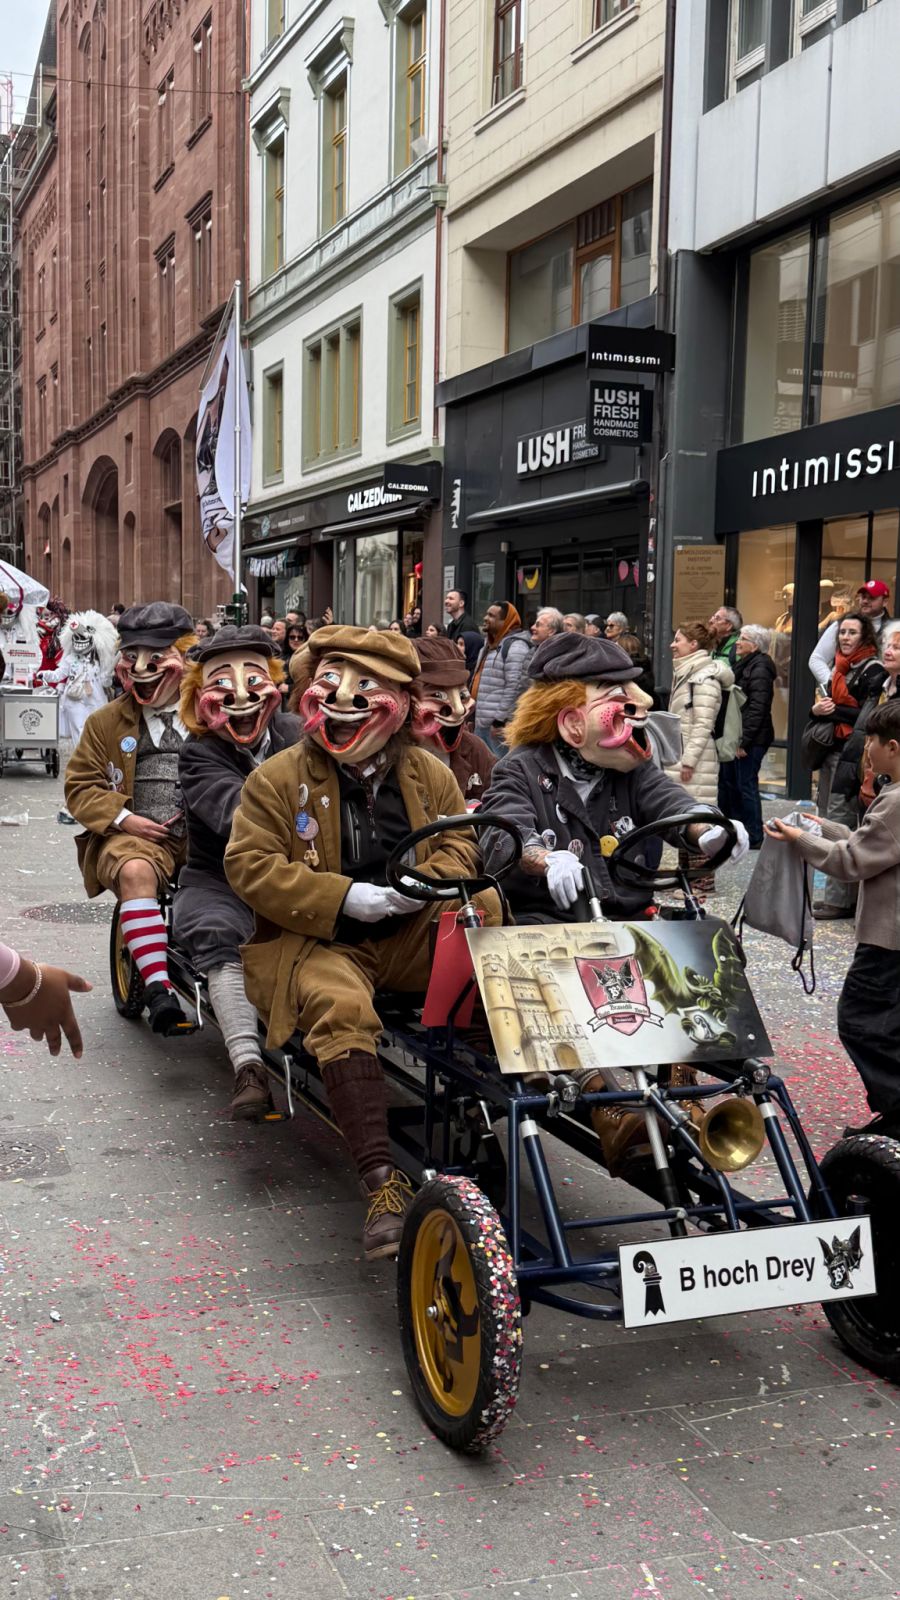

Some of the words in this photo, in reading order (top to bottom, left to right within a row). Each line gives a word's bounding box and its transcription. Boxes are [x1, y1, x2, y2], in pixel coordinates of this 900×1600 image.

[591, 352, 660, 365] intimissimi
[594, 388, 639, 406] LUSH
[593, 404, 639, 420] FRESH
[593, 419, 639, 429] HANDMADE
[593, 427, 639, 438] COSMETICS
[517, 428, 571, 474] LUSH
[572, 446, 599, 461] COSMETICS
[752, 440, 894, 498] intimissi
[387, 482, 429, 492] CALZEDONIA
[679, 1267, 696, 1292] B
[703, 1260, 759, 1288] hoch
[766, 1256, 816, 1282] Drey
